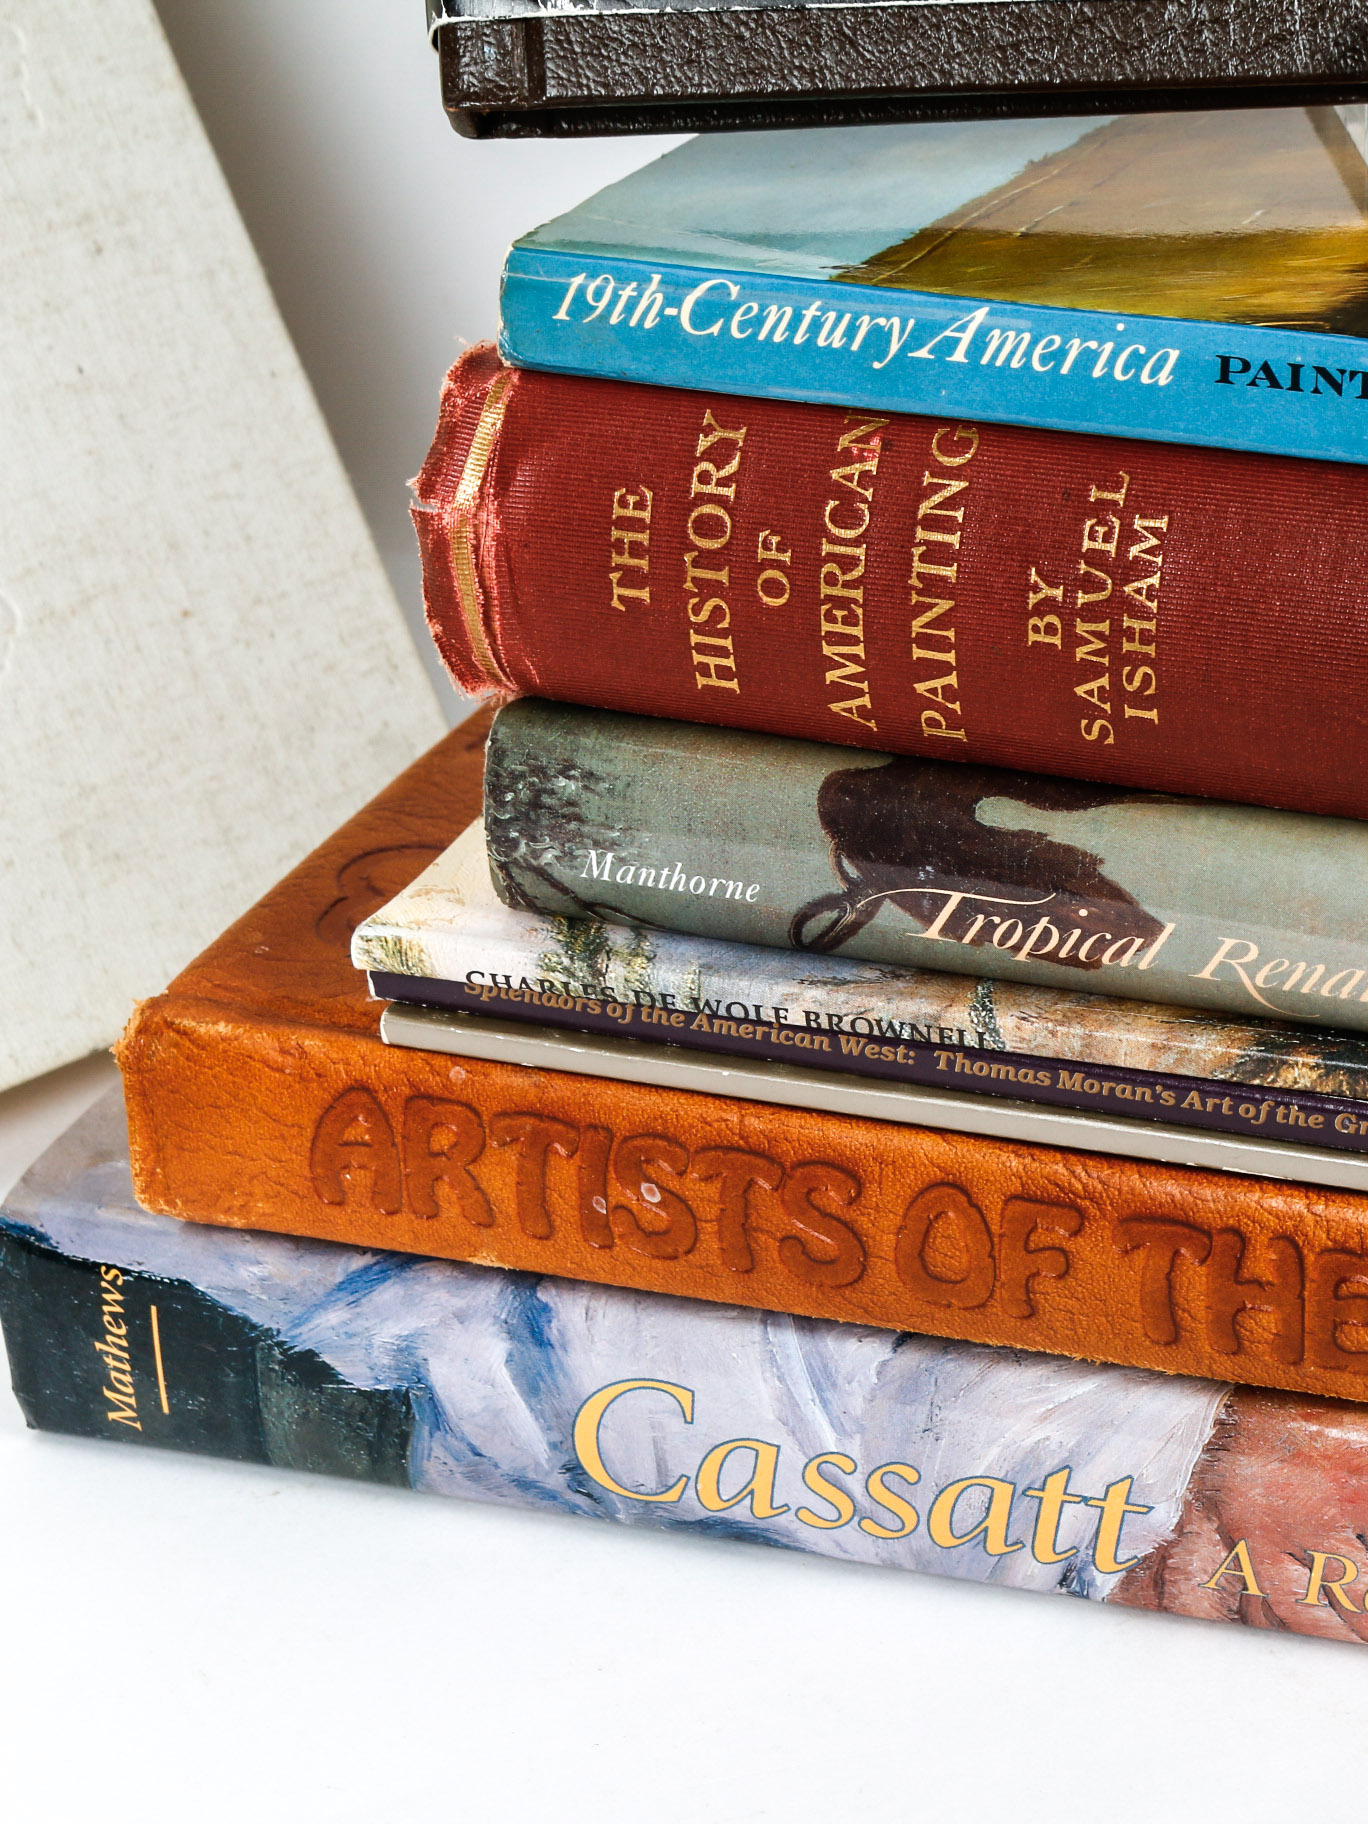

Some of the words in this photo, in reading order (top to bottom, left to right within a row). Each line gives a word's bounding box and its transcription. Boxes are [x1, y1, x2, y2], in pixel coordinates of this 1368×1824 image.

[552, 271, 917, 369] 19th-Century
[909, 307, 1181, 386] America
[609, 484, 653, 611] THE
[685, 408, 748, 694] HISTORY
[757, 529, 792, 606] OF
[820, 410, 891, 731] AMERICAN
[910, 426, 980, 743] PAINTING
[1027, 566, 1063, 650] BY
[1076, 470, 1130, 745] SAMVEL
[1123, 514, 1169, 726] ISHAM
[579, 850, 760, 903] Manthorne
[857, 888, 1176, 971] Tropical
[607, 1001, 632, 1024] of
[640, 1003, 685, 1028] the
[690, 1013, 832, 1052] American
[838, 1034, 916, 1065] West:
[933, 1050, 1052, 1088] Thomas
[1057, 1068, 1175, 1106] Moran's
[1180, 1089, 1235, 1119] Art
[1238, 1101, 1275, 1125] of
[1276, 1104, 1324, 1128] the
[308, 1085, 869, 1289] ARTISTS
[895, 1182, 1084, 1318] OF
[93, 1265, 142, 1432] Mathews
[572, 1377, 1153, 1574] Cassatt
[1200, 1538, 1270, 1599] A
